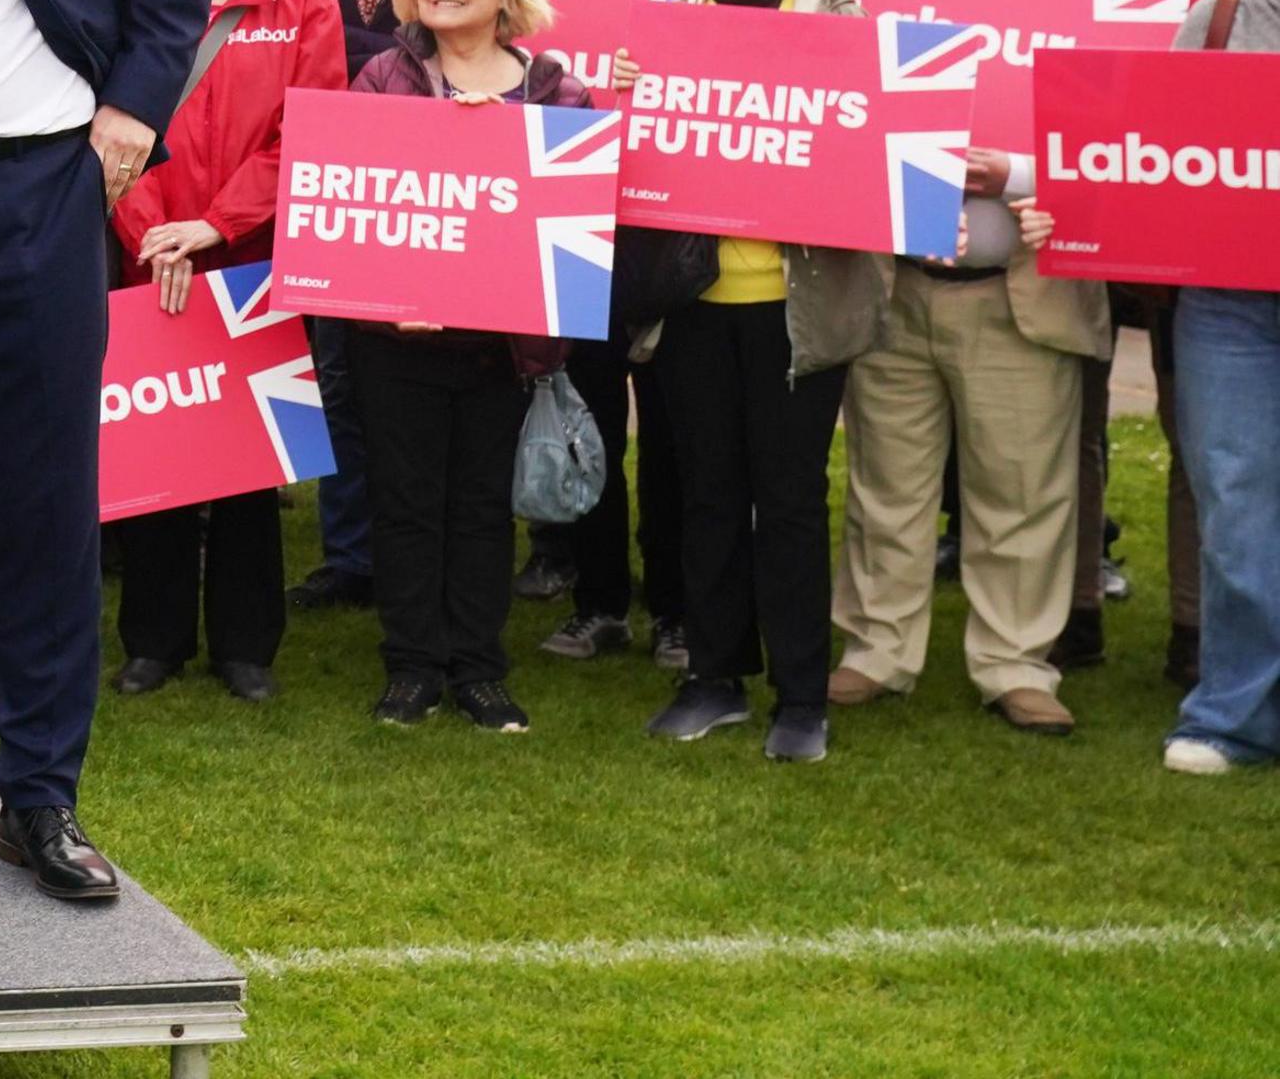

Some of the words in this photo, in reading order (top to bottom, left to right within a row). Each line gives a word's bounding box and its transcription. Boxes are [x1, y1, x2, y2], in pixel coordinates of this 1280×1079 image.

[241, 26, 299, 43] Labour
[630, 73, 869, 130] BRITAIN'S
[626, 113, 814, 168] FUTURE
[289, 160, 520, 215] BRITAIN'S
[286, 202, 469, 253] FUTURE
